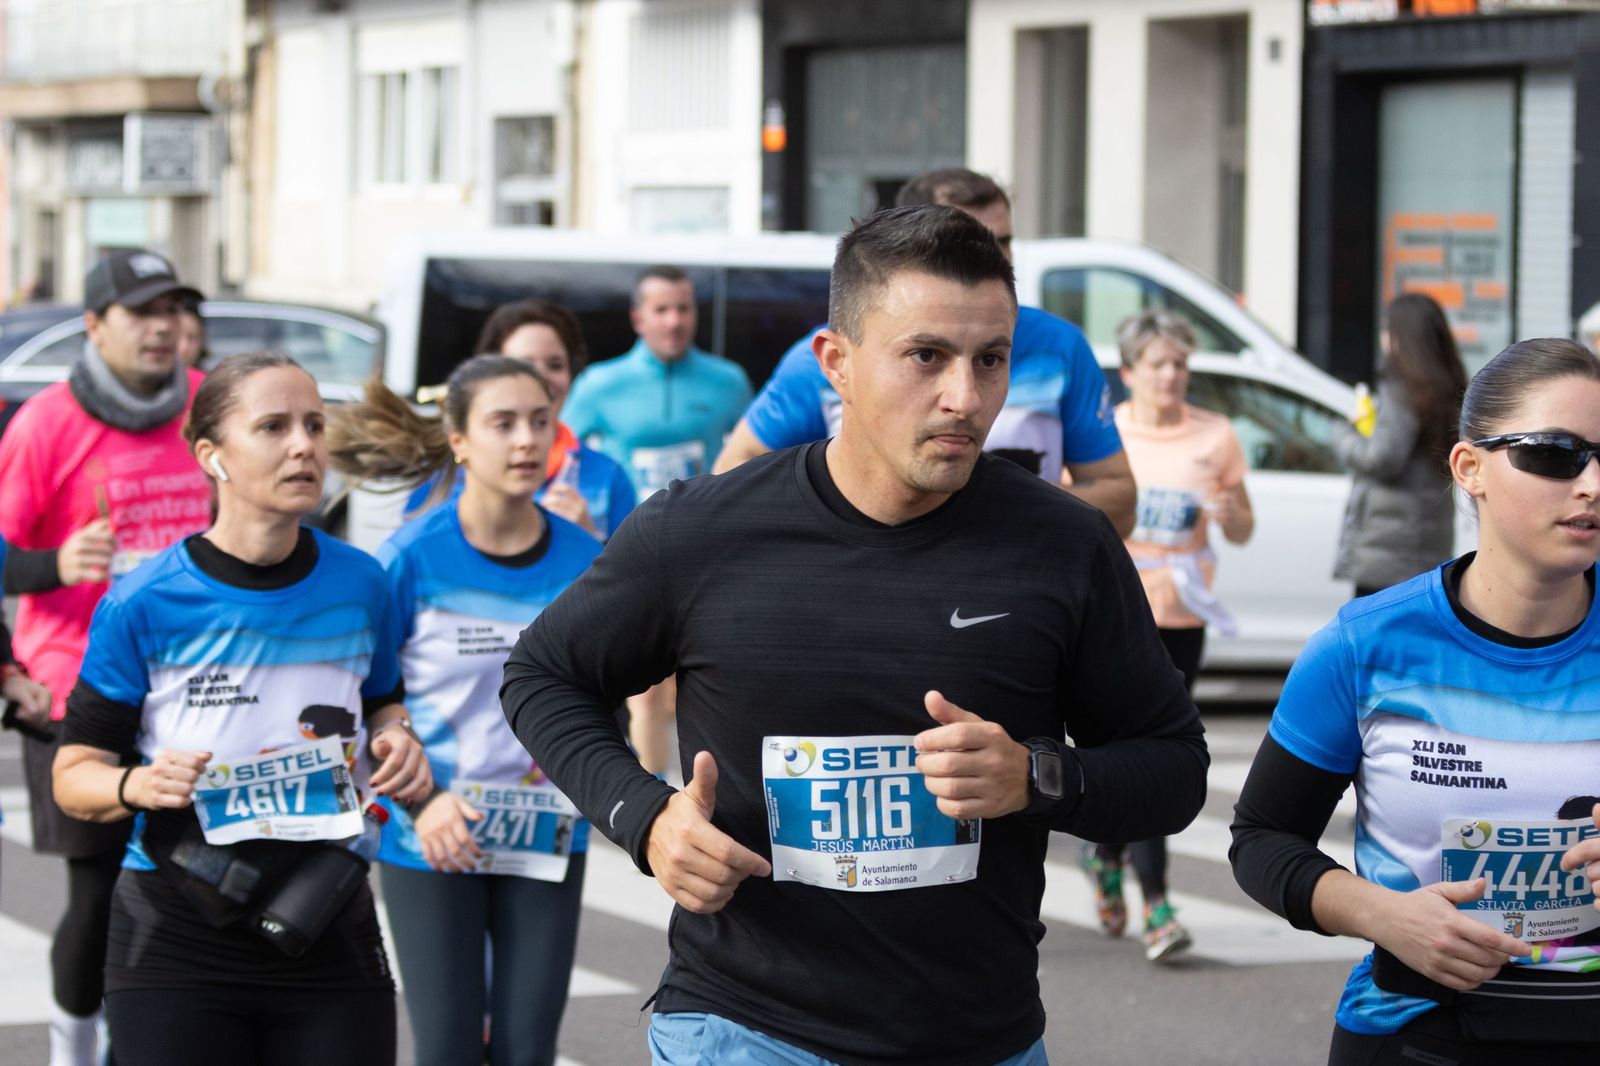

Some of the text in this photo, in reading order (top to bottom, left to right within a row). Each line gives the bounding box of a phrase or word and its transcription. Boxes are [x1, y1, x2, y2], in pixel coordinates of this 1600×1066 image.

[109, 478, 141, 501] En
[115, 497, 198, 527] contra
[188, 685, 242, 696] SILVESTRE
[188, 695, 259, 708] SALMANTINA
[1411, 739, 1466, 756] XLI SAN
[235, 748, 332, 782] SETEL
[1412, 755, 1483, 773] SILVESTRE
[1410, 770, 1508, 790] SALMANTINA
[225, 775, 309, 818] 4617
[485, 790, 562, 808] SETEL
[811, 776, 912, 840] 5116
[811, 835, 915, 853] JESÚS MARTÍN
[861, 863, 918, 876] Ayuntamiento
[1468, 852, 1592, 901] 4448
[862, 875, 918, 886] de Salamanca
[1477, 899, 1527, 911] SILVIA
[1527, 915, 1580, 928] Ayuntamiento
[1526, 926, 1579, 938] de Salamanca
